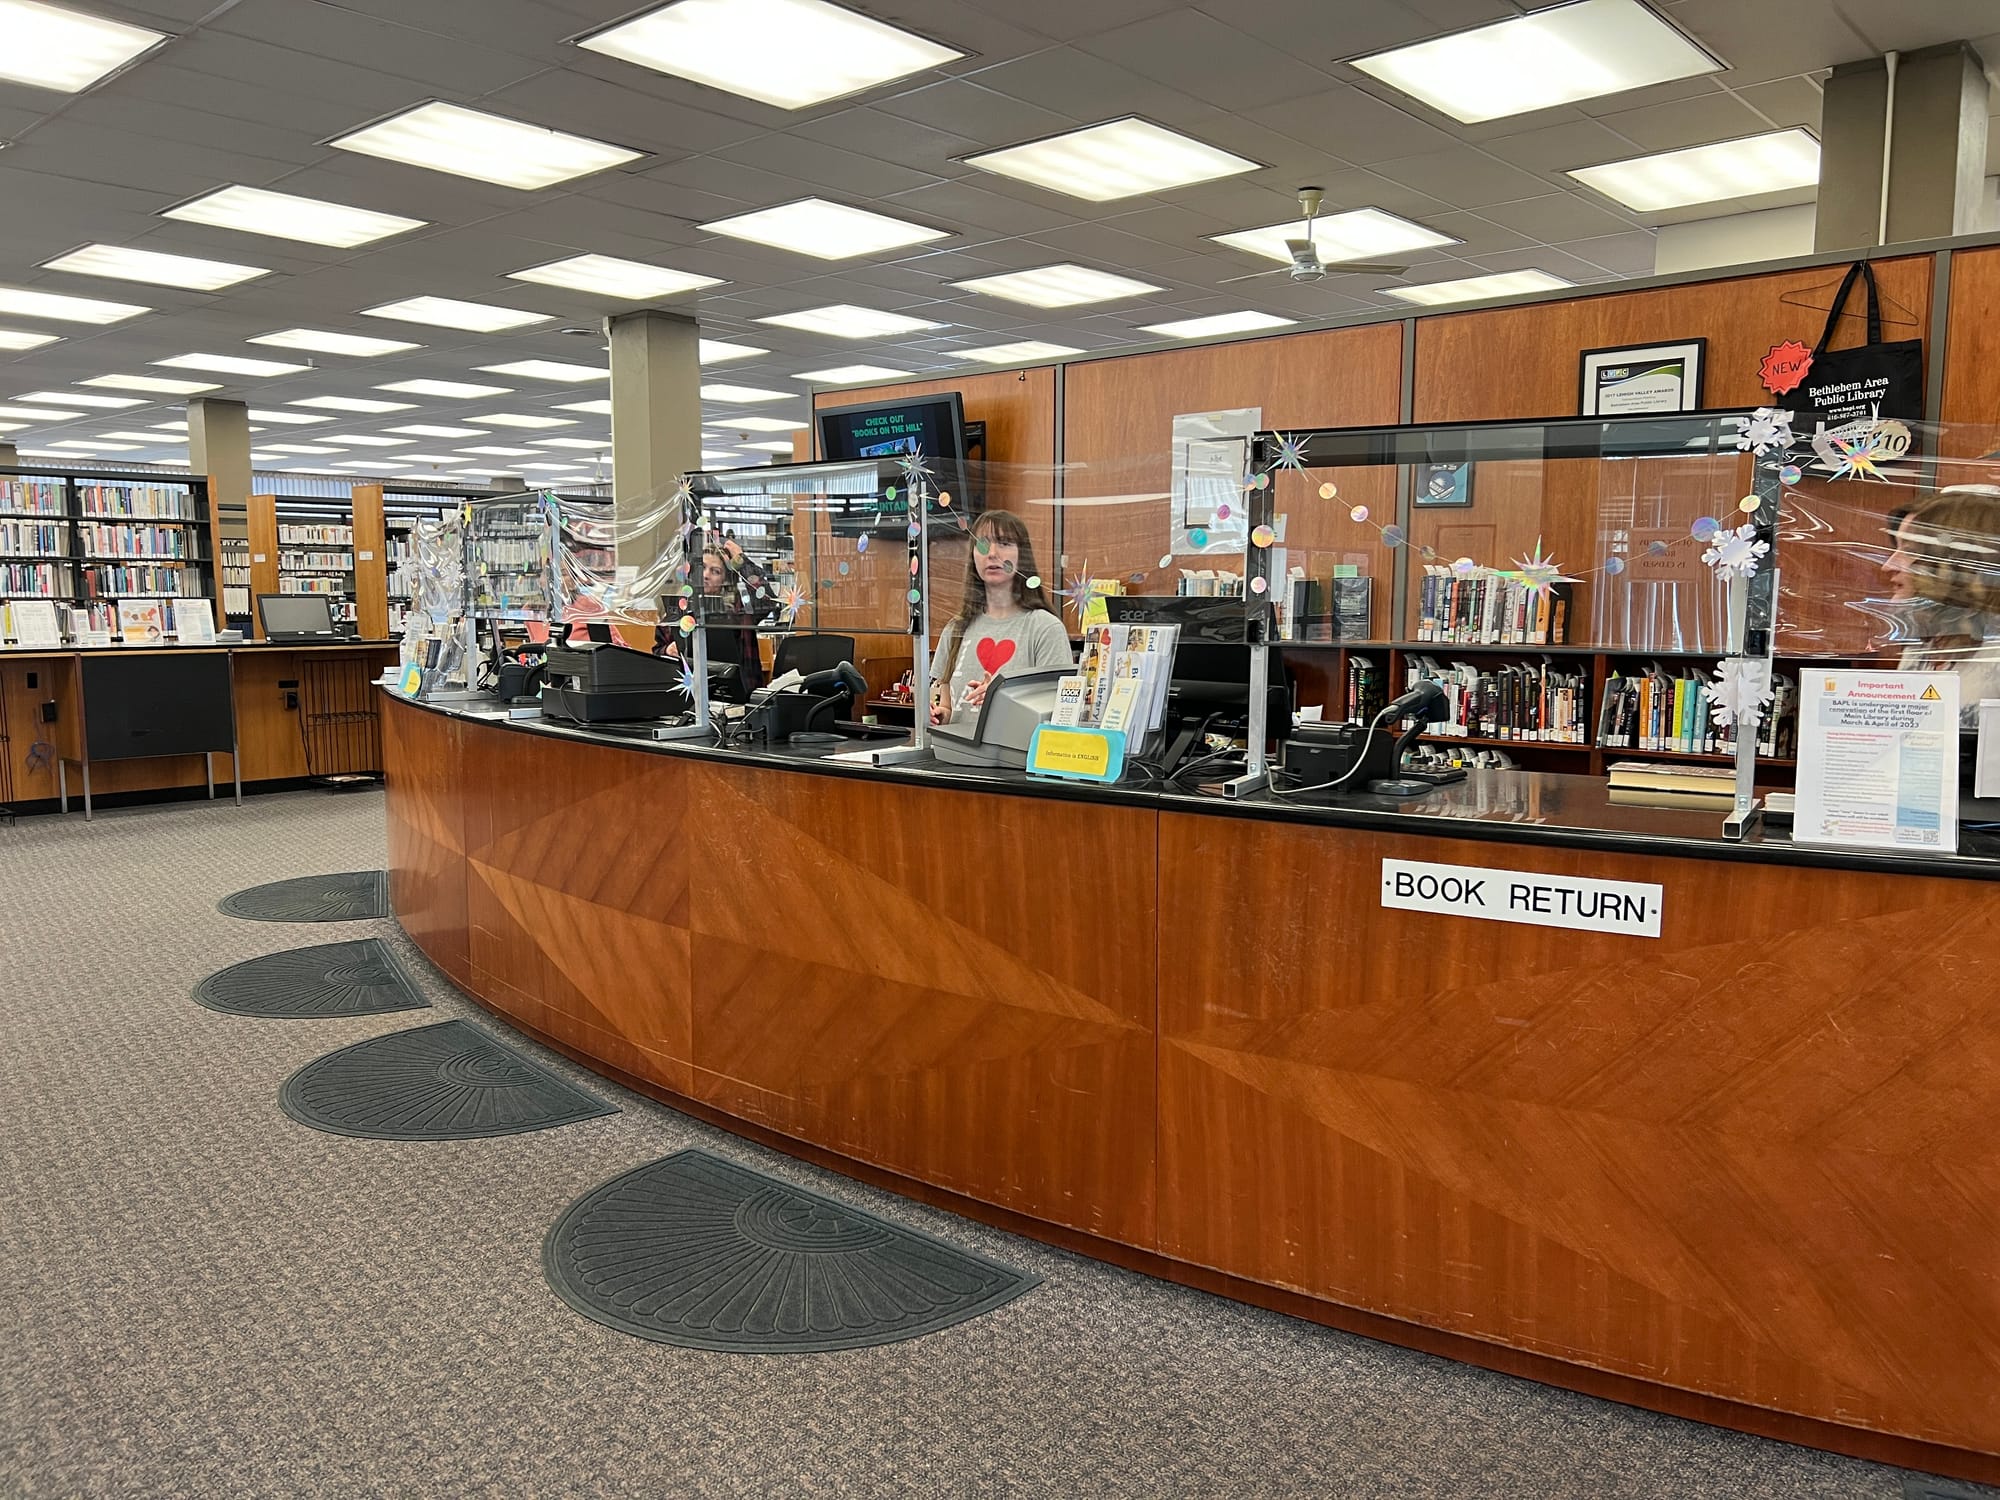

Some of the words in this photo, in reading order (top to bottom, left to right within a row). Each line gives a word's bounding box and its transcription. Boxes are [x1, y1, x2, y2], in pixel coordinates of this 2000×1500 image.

[1772, 359, 1802, 375] NEW
[1808, 382, 1862, 398] Bethlehem
[1864, 377, 1889, 389] Area
[1814, 394, 1845, 407] Public
[1847, 388, 1886, 402] Library
[866, 418, 888, 427] CHECK
[890, 415, 904, 424] OUT
[880, 426, 890, 435] ON
[891, 425, 904, 434] THE
[1120, 610, 1148, 621] acer
[1100, 644, 1111, 674] Your
[1858, 680, 1904, 689] Important
[1061, 689, 1080, 697] BOOK
[1092, 678, 1107, 720] Library
[1848, 691, 1916, 700] Announcement
[1863, 714, 1888, 722] Library
[1890, 715, 1914, 723] during
[1395, 871, 1486, 907] BOOK
[1510, 883, 1645, 923] RETURN
